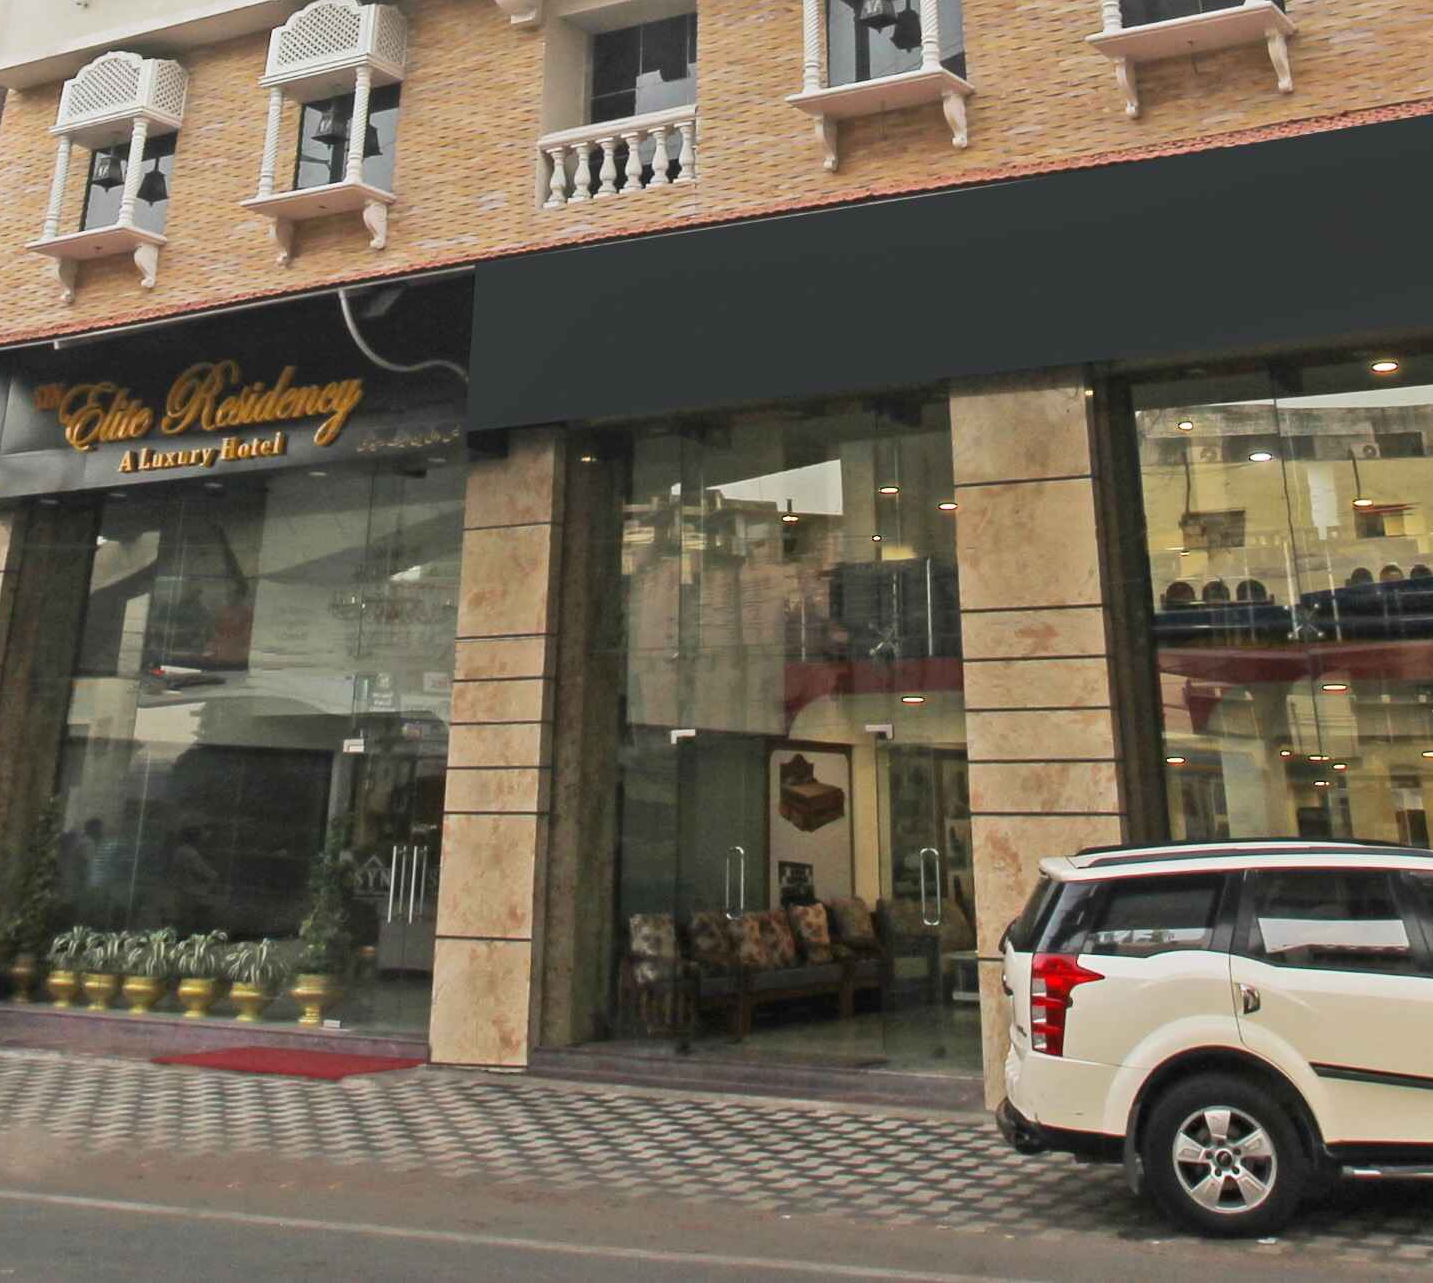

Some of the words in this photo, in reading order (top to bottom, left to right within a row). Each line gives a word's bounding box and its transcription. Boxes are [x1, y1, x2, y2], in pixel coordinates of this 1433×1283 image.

[59, 382, 154, 452] Elite
[161, 359, 363, 446] Residency
[118, 450, 134, 473] A
[138, 447, 214, 470] Luxury
[220, 431, 285, 461] Hotel
